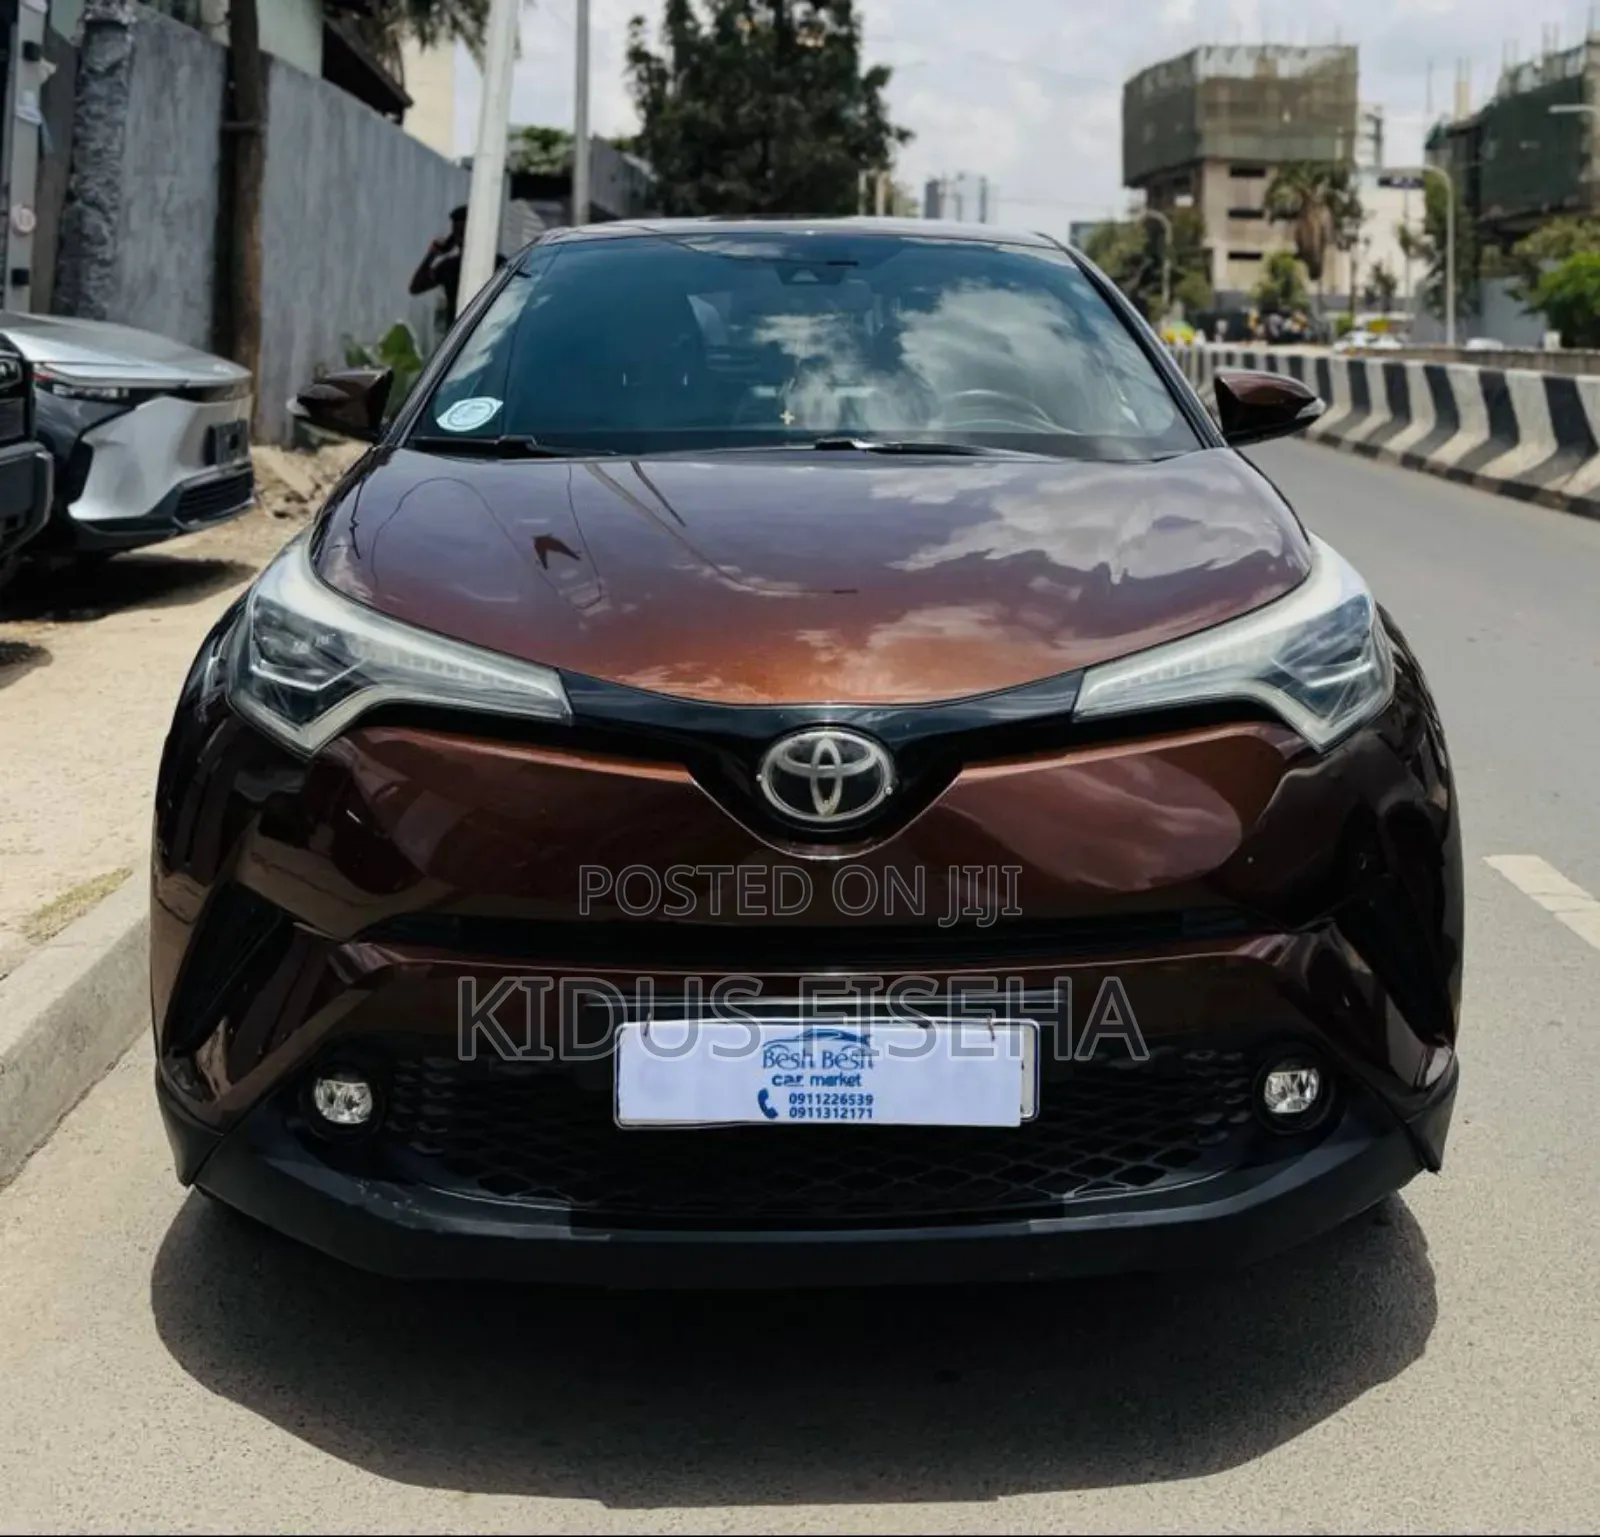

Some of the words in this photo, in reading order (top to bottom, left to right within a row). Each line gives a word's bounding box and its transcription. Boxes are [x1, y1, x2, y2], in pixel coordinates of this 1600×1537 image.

[762, 1047, 815, 1070] Besh
[822, 1047, 874, 1070] Besh
[771, 1074, 804, 1087] car
[810, 1072, 862, 1087] market
[788, 1092, 874, 1106] 0911226539
[788, 1107, 873, 1119] 0911312171
